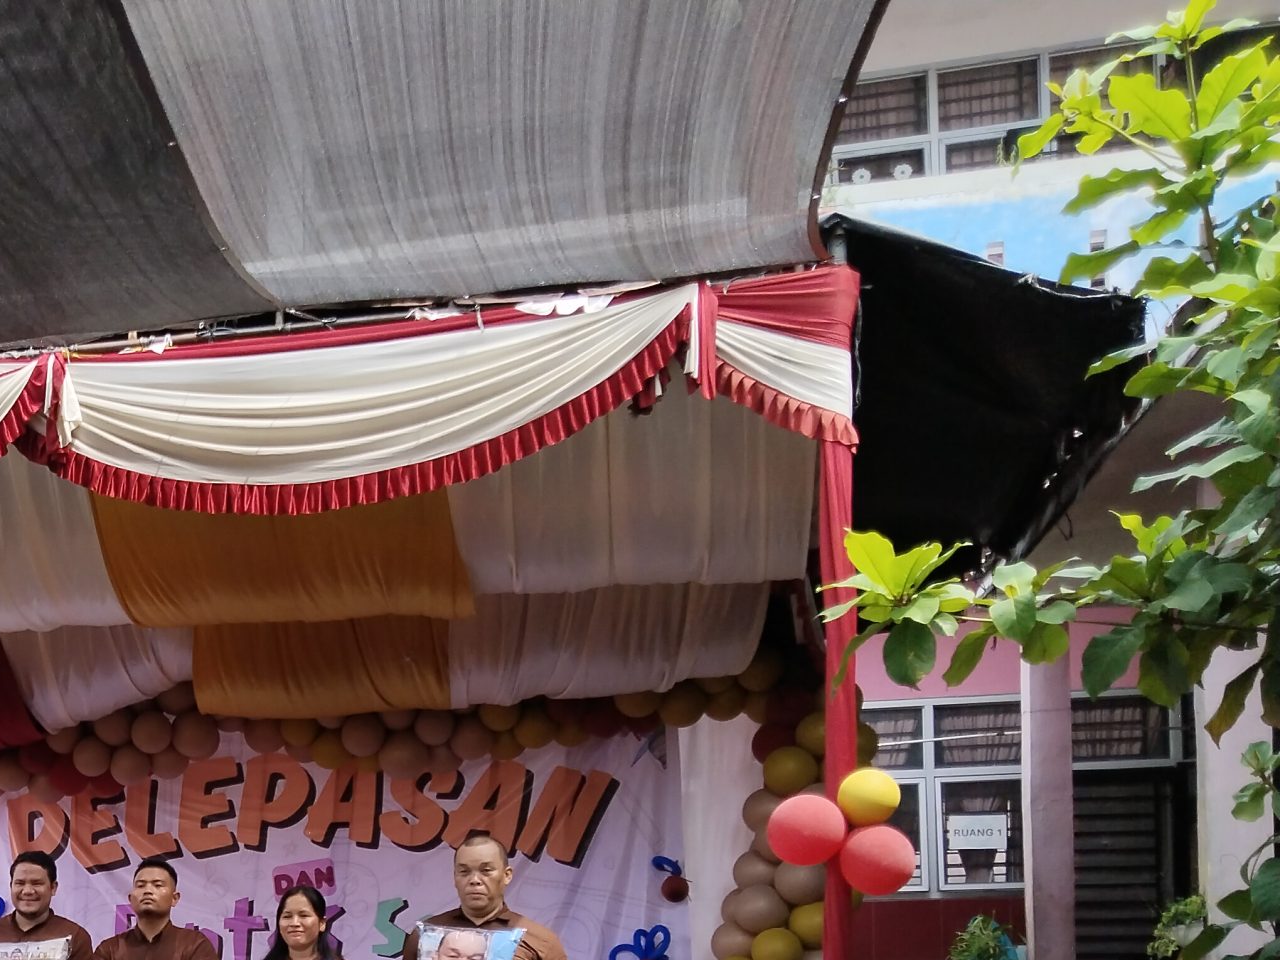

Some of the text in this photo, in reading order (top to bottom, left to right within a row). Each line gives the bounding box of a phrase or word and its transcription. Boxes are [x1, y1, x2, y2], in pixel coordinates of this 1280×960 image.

[7, 755, 620, 875] DELEPASAN
[953, 828, 1002, 837] RUANG 1
[274, 865, 335, 896] DAN
